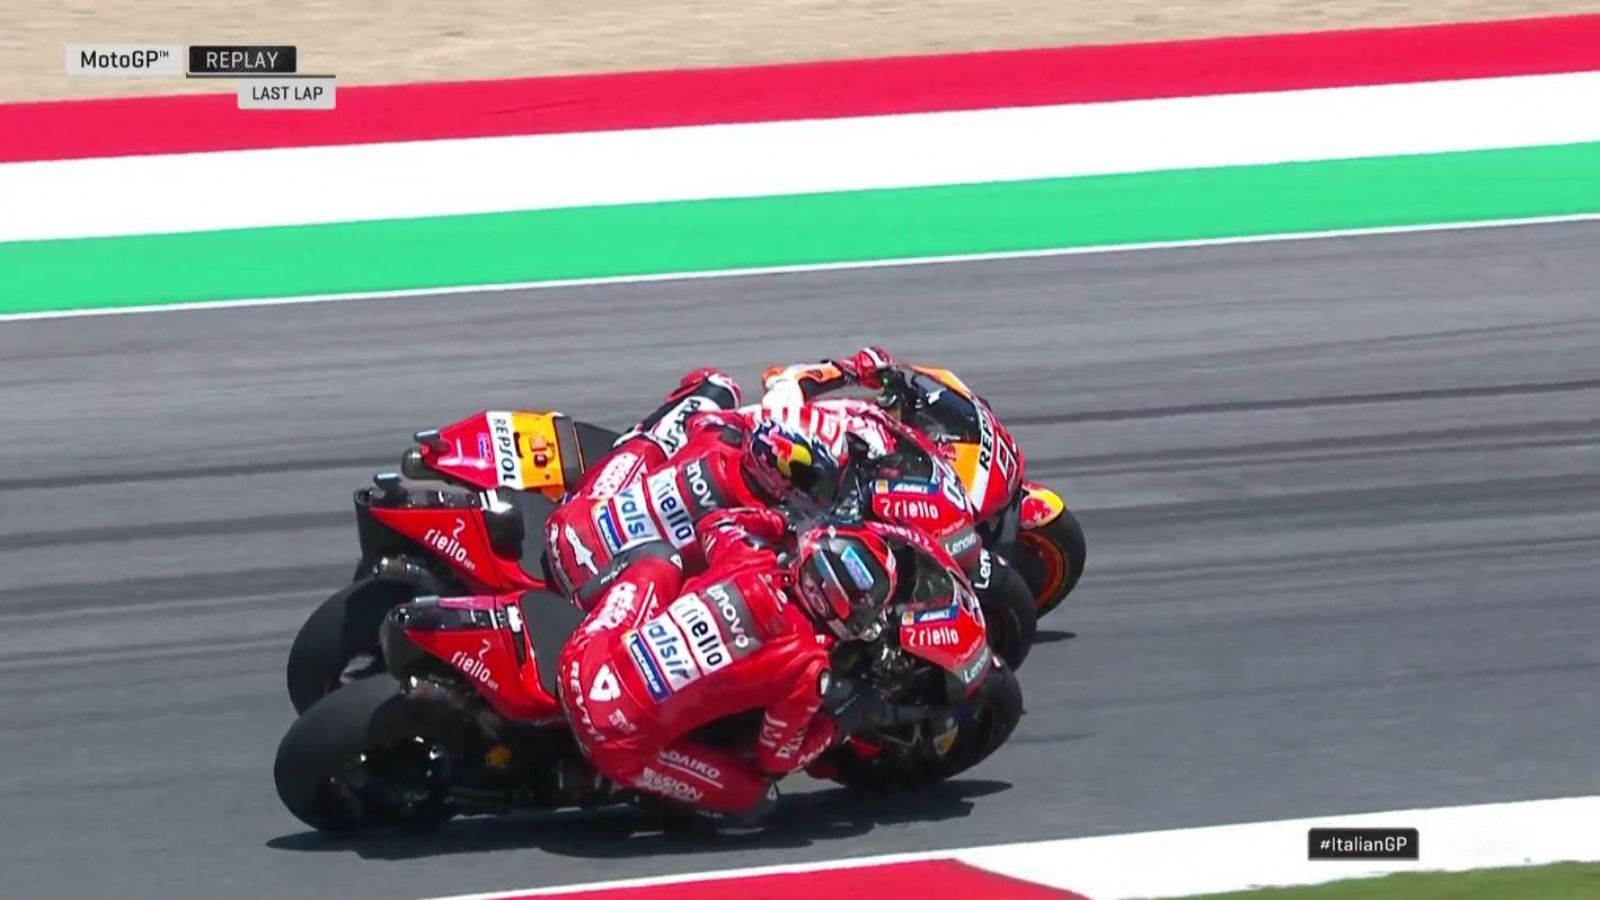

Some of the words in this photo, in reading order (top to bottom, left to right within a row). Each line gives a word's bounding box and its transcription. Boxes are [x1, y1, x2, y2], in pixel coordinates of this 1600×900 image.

[493, 418, 516, 482] REPSOL
[895, 499, 939, 520] riello
[424, 528, 467, 562] riello
[975, 548, 992, 590] Len
[919, 626, 959, 646] riello
[451, 650, 492, 683] riello
